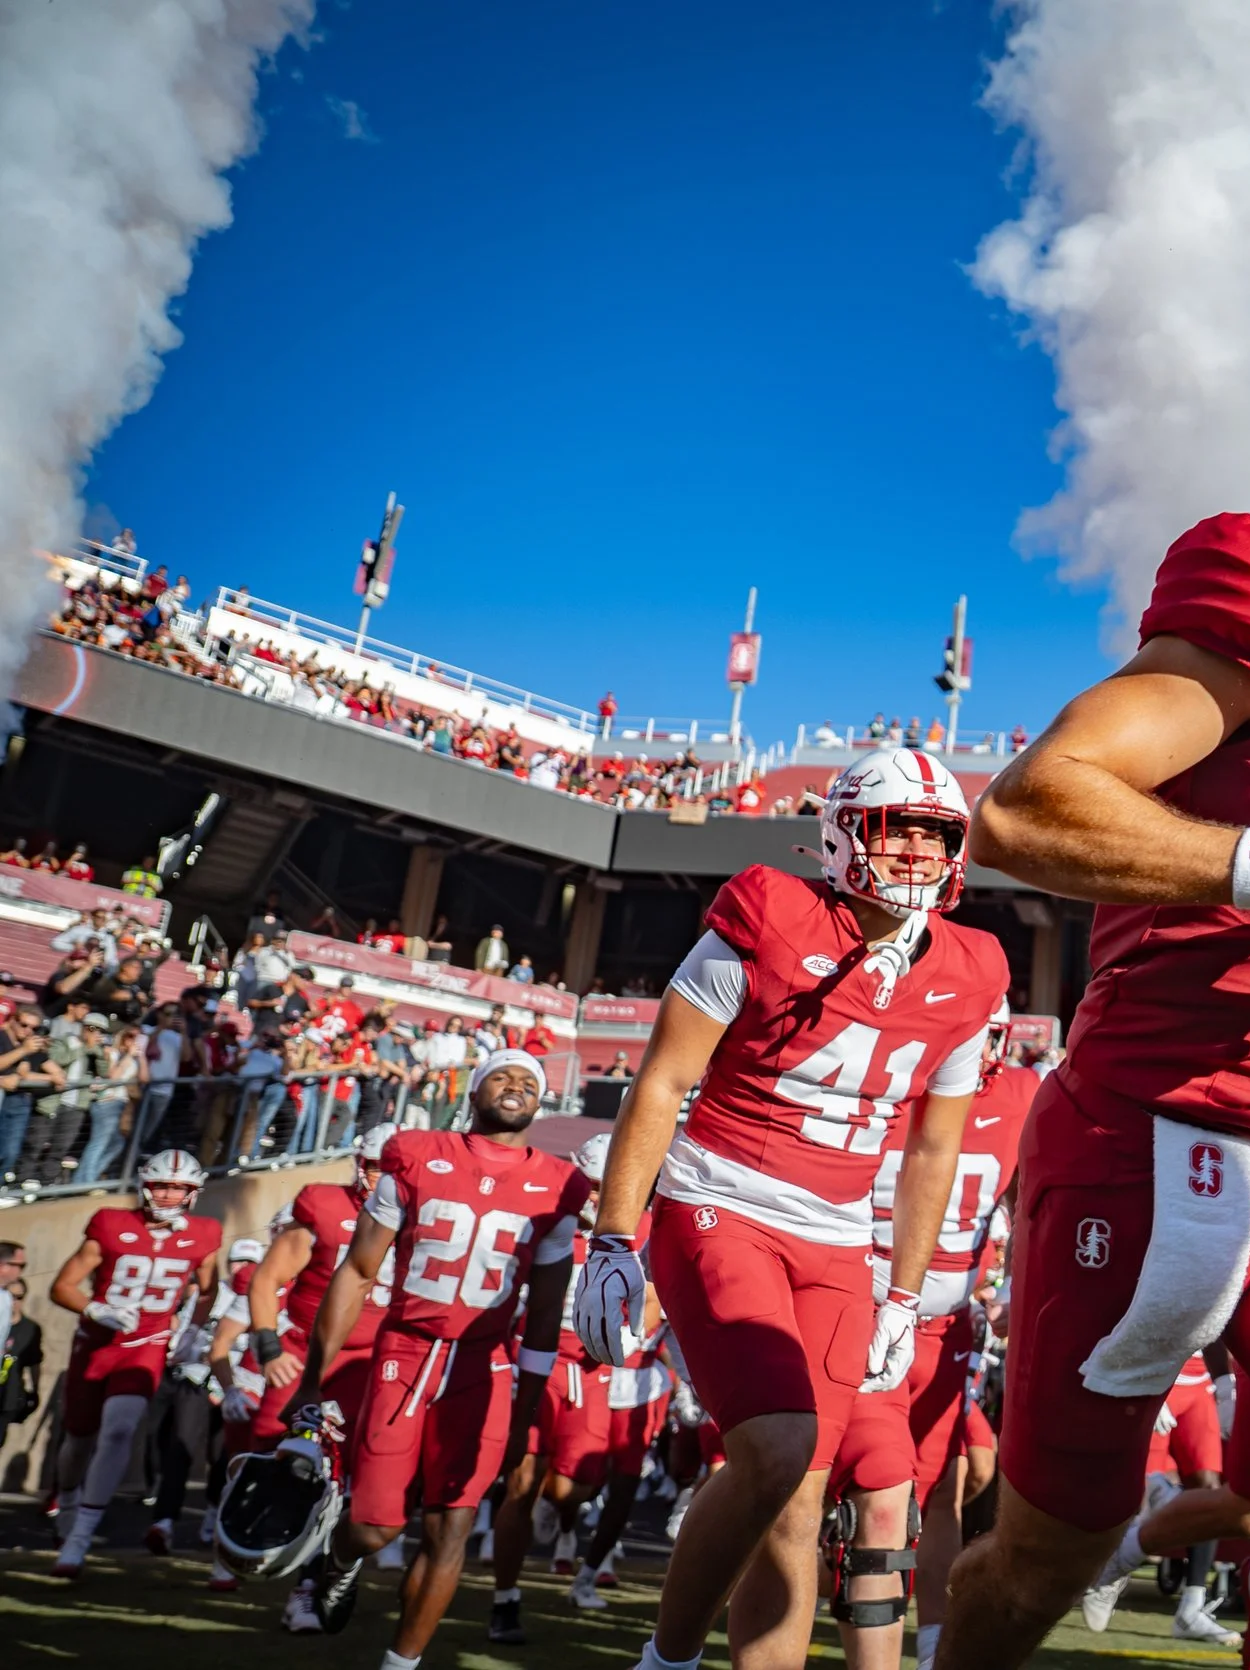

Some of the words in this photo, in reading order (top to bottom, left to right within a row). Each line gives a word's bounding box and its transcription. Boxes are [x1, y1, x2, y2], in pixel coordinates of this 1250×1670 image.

[807, 958, 835, 972] ACC
[775, 1021, 928, 1156] 41
[105, 1253, 191, 1314] 85
[402, 1198, 534, 1309] 26
